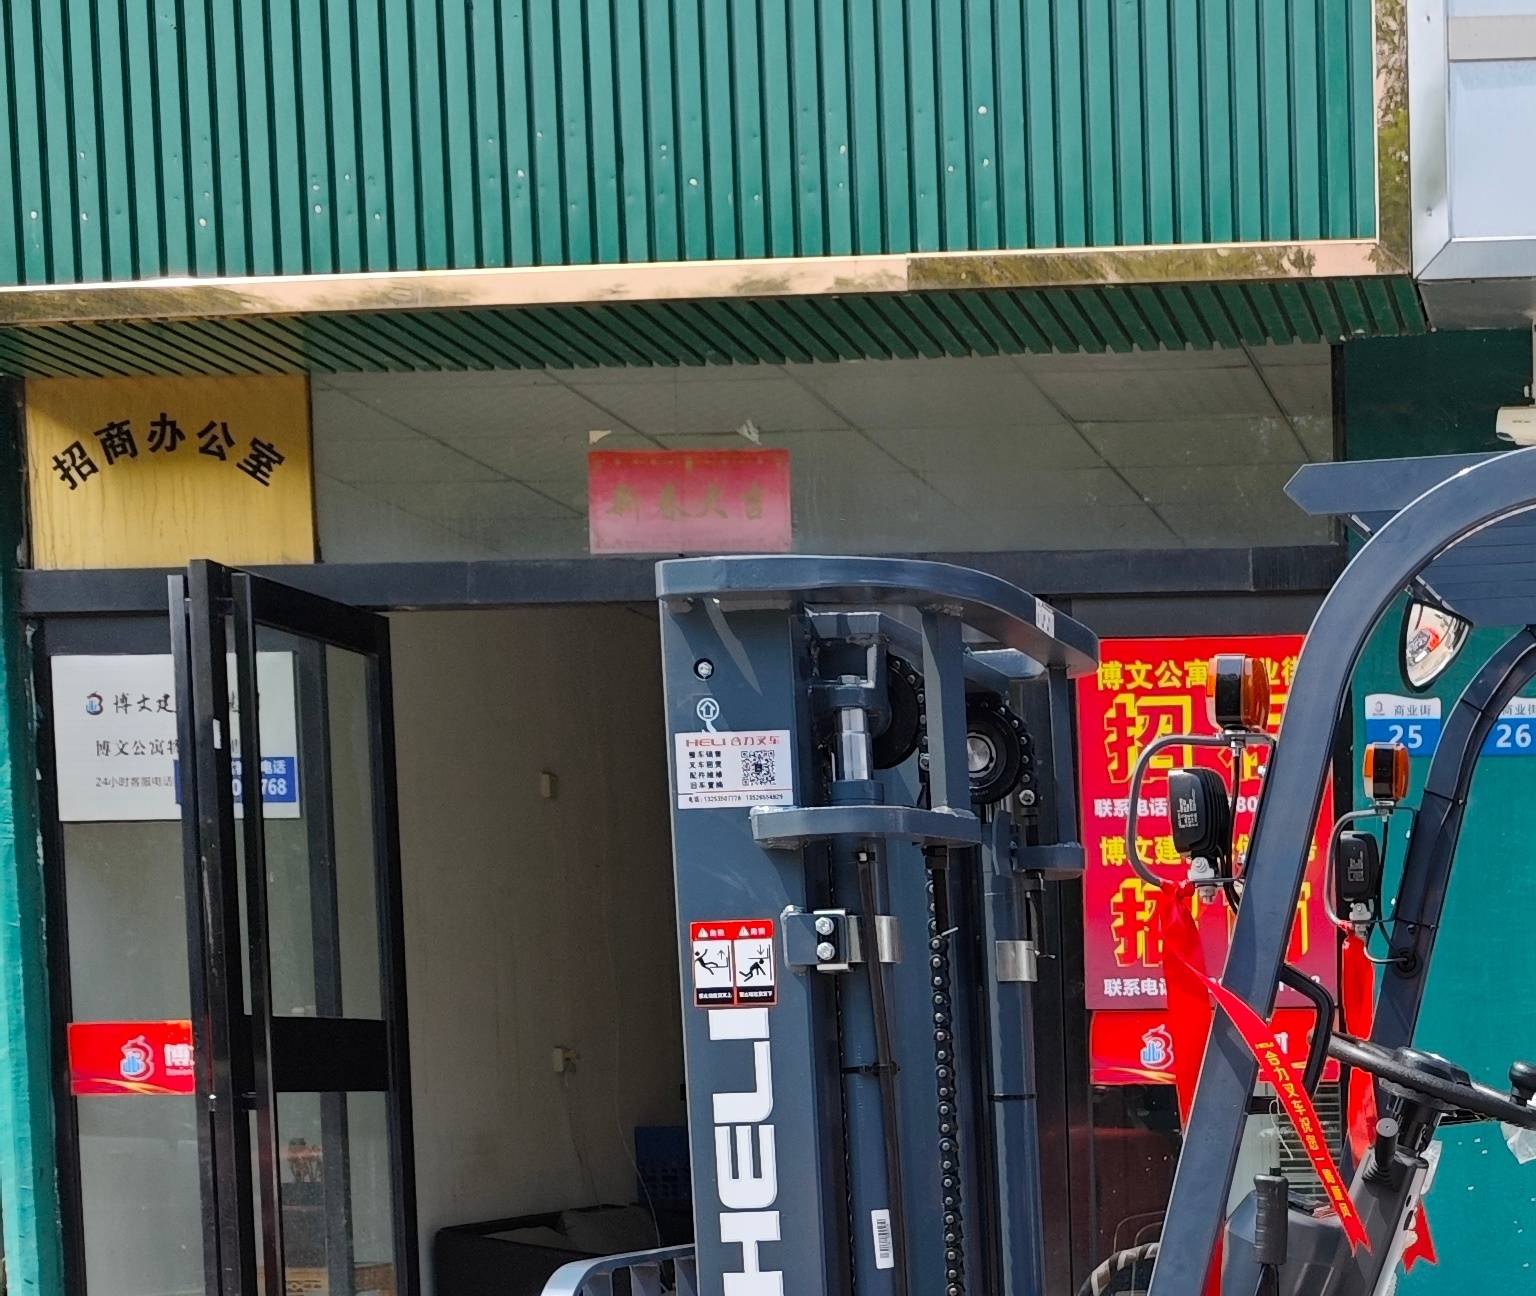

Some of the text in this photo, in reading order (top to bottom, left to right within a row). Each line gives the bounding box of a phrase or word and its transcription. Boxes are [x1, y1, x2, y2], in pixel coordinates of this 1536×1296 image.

[52, 413, 286, 490] 招商办公室
[1394, 704, 1431, 717] 商业街
[1389, 725, 1422, 749] 25
[1496, 723, 1532, 748] 26
